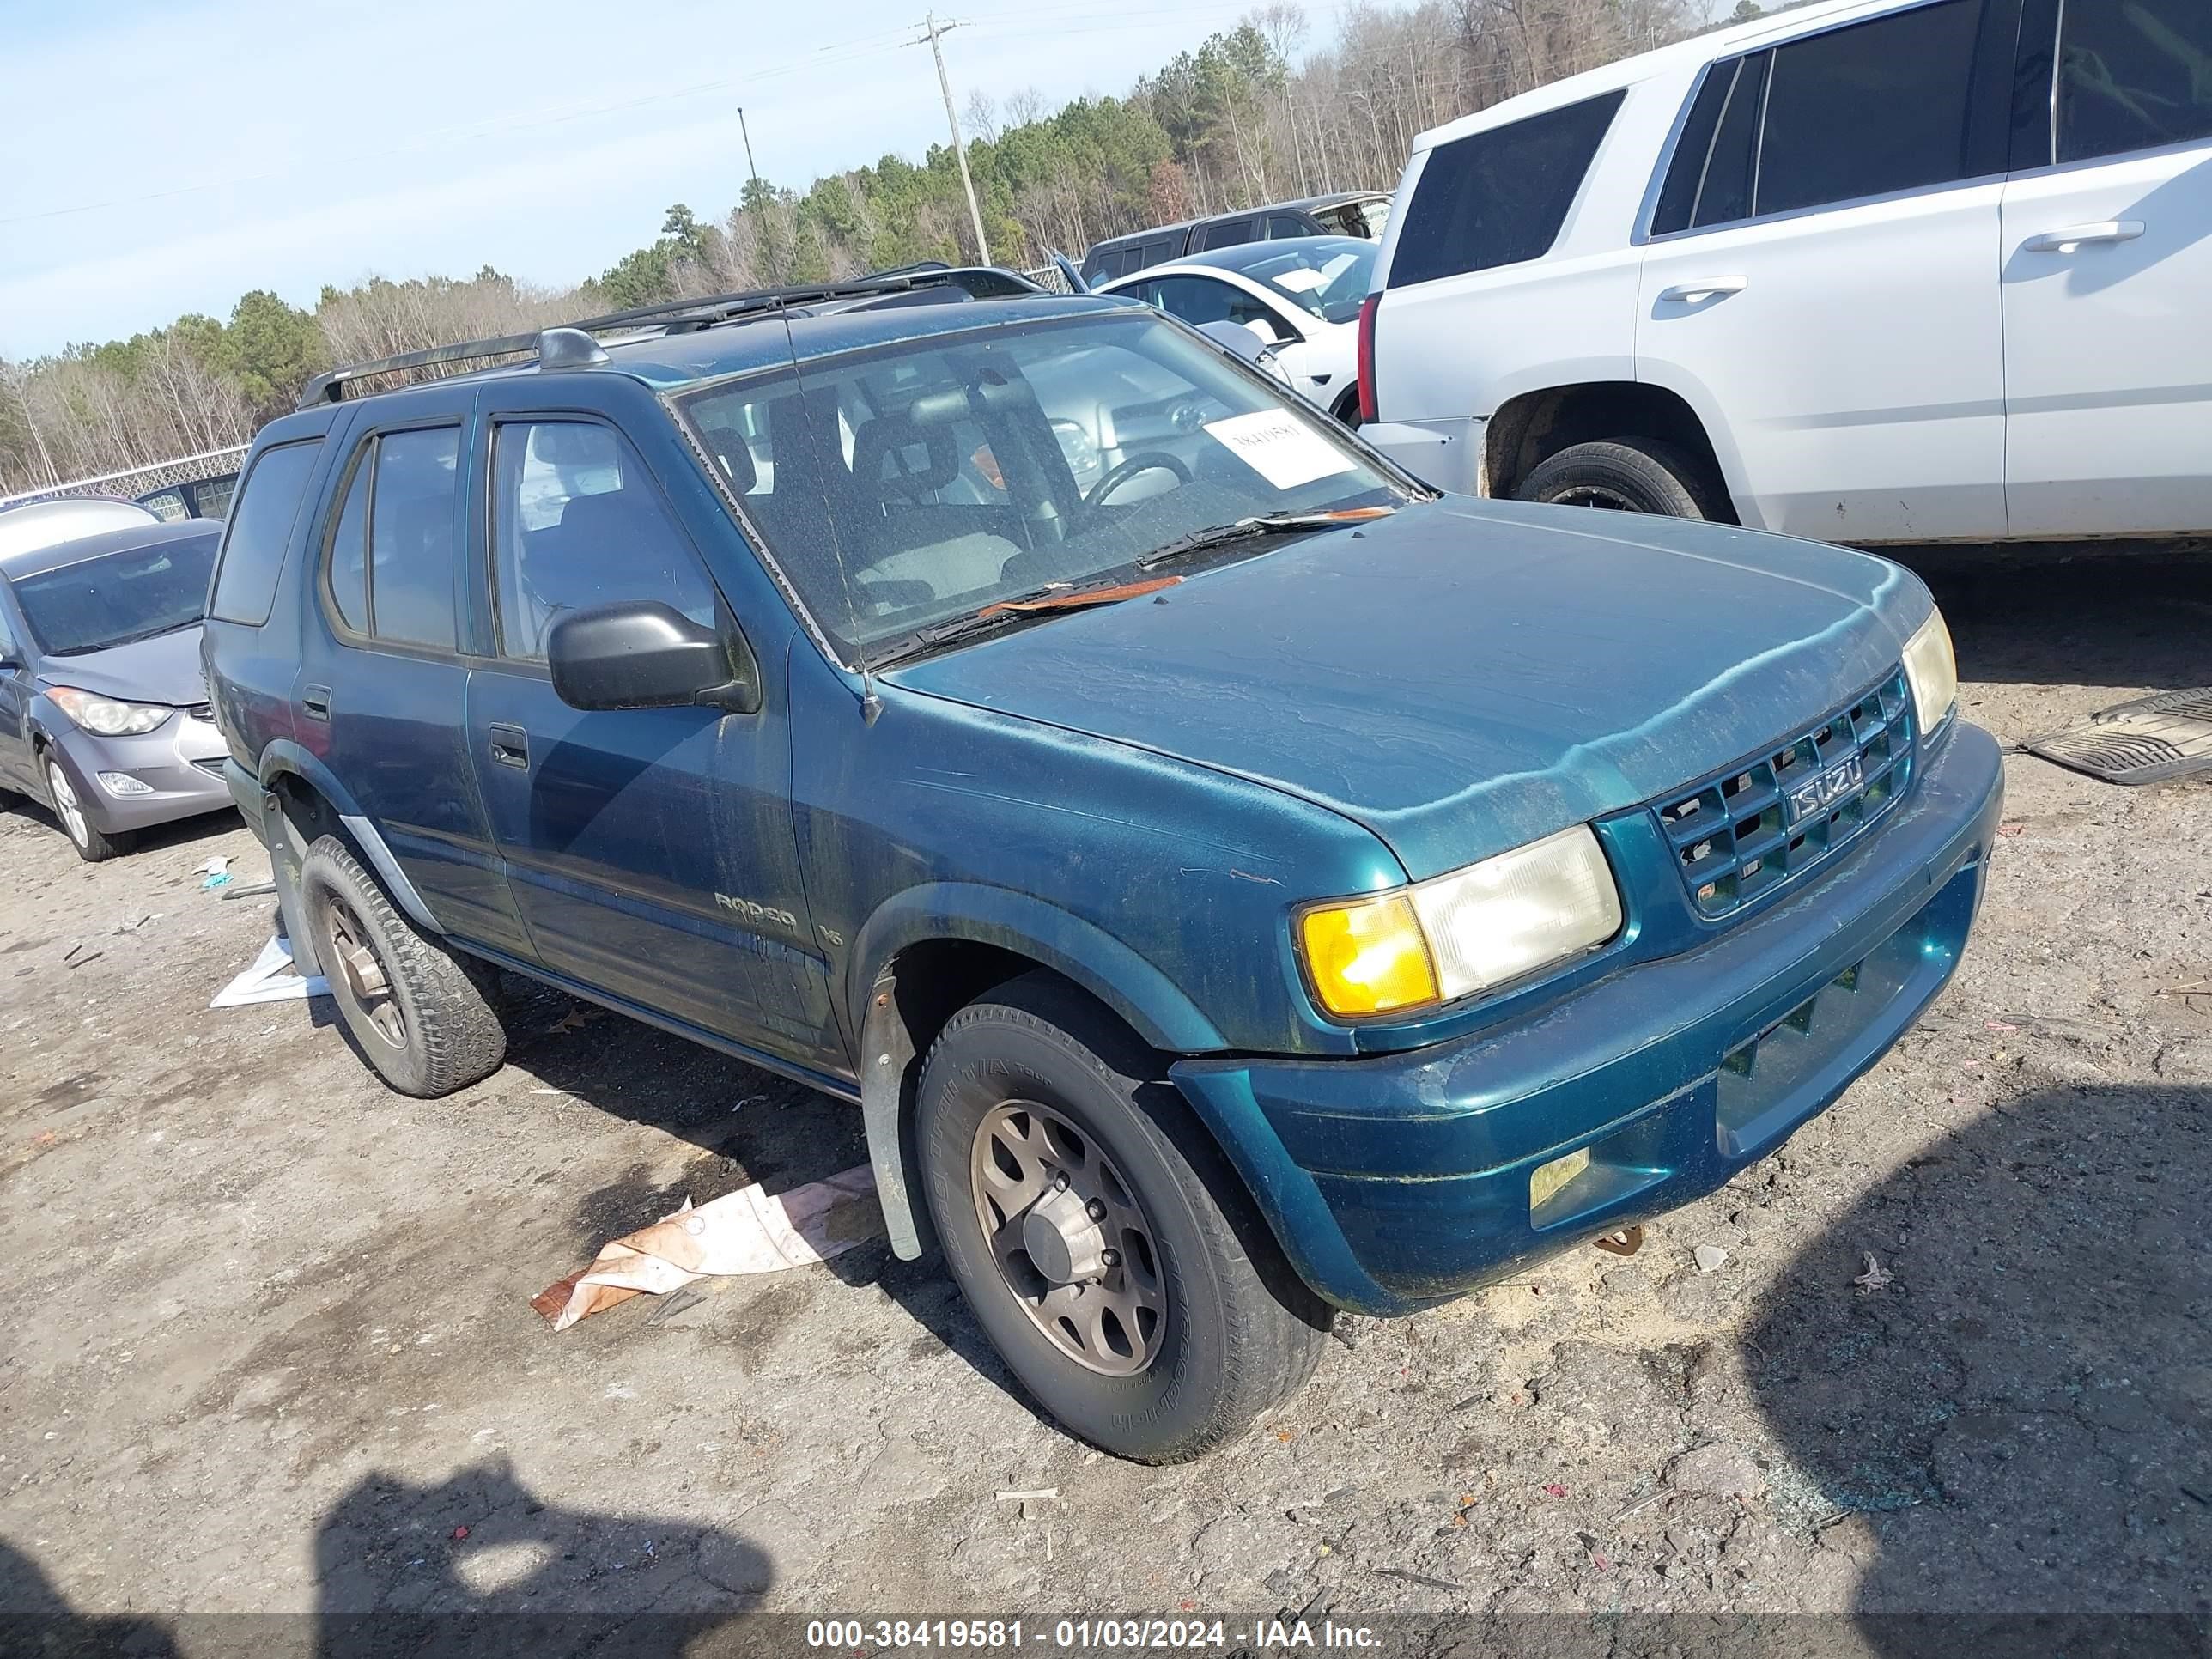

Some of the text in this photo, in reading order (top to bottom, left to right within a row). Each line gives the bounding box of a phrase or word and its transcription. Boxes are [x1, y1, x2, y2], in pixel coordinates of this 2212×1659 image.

[1790, 756, 1863, 822] ISUZU
[714, 892, 797, 927] RODEO
[818, 925, 844, 946] V6
